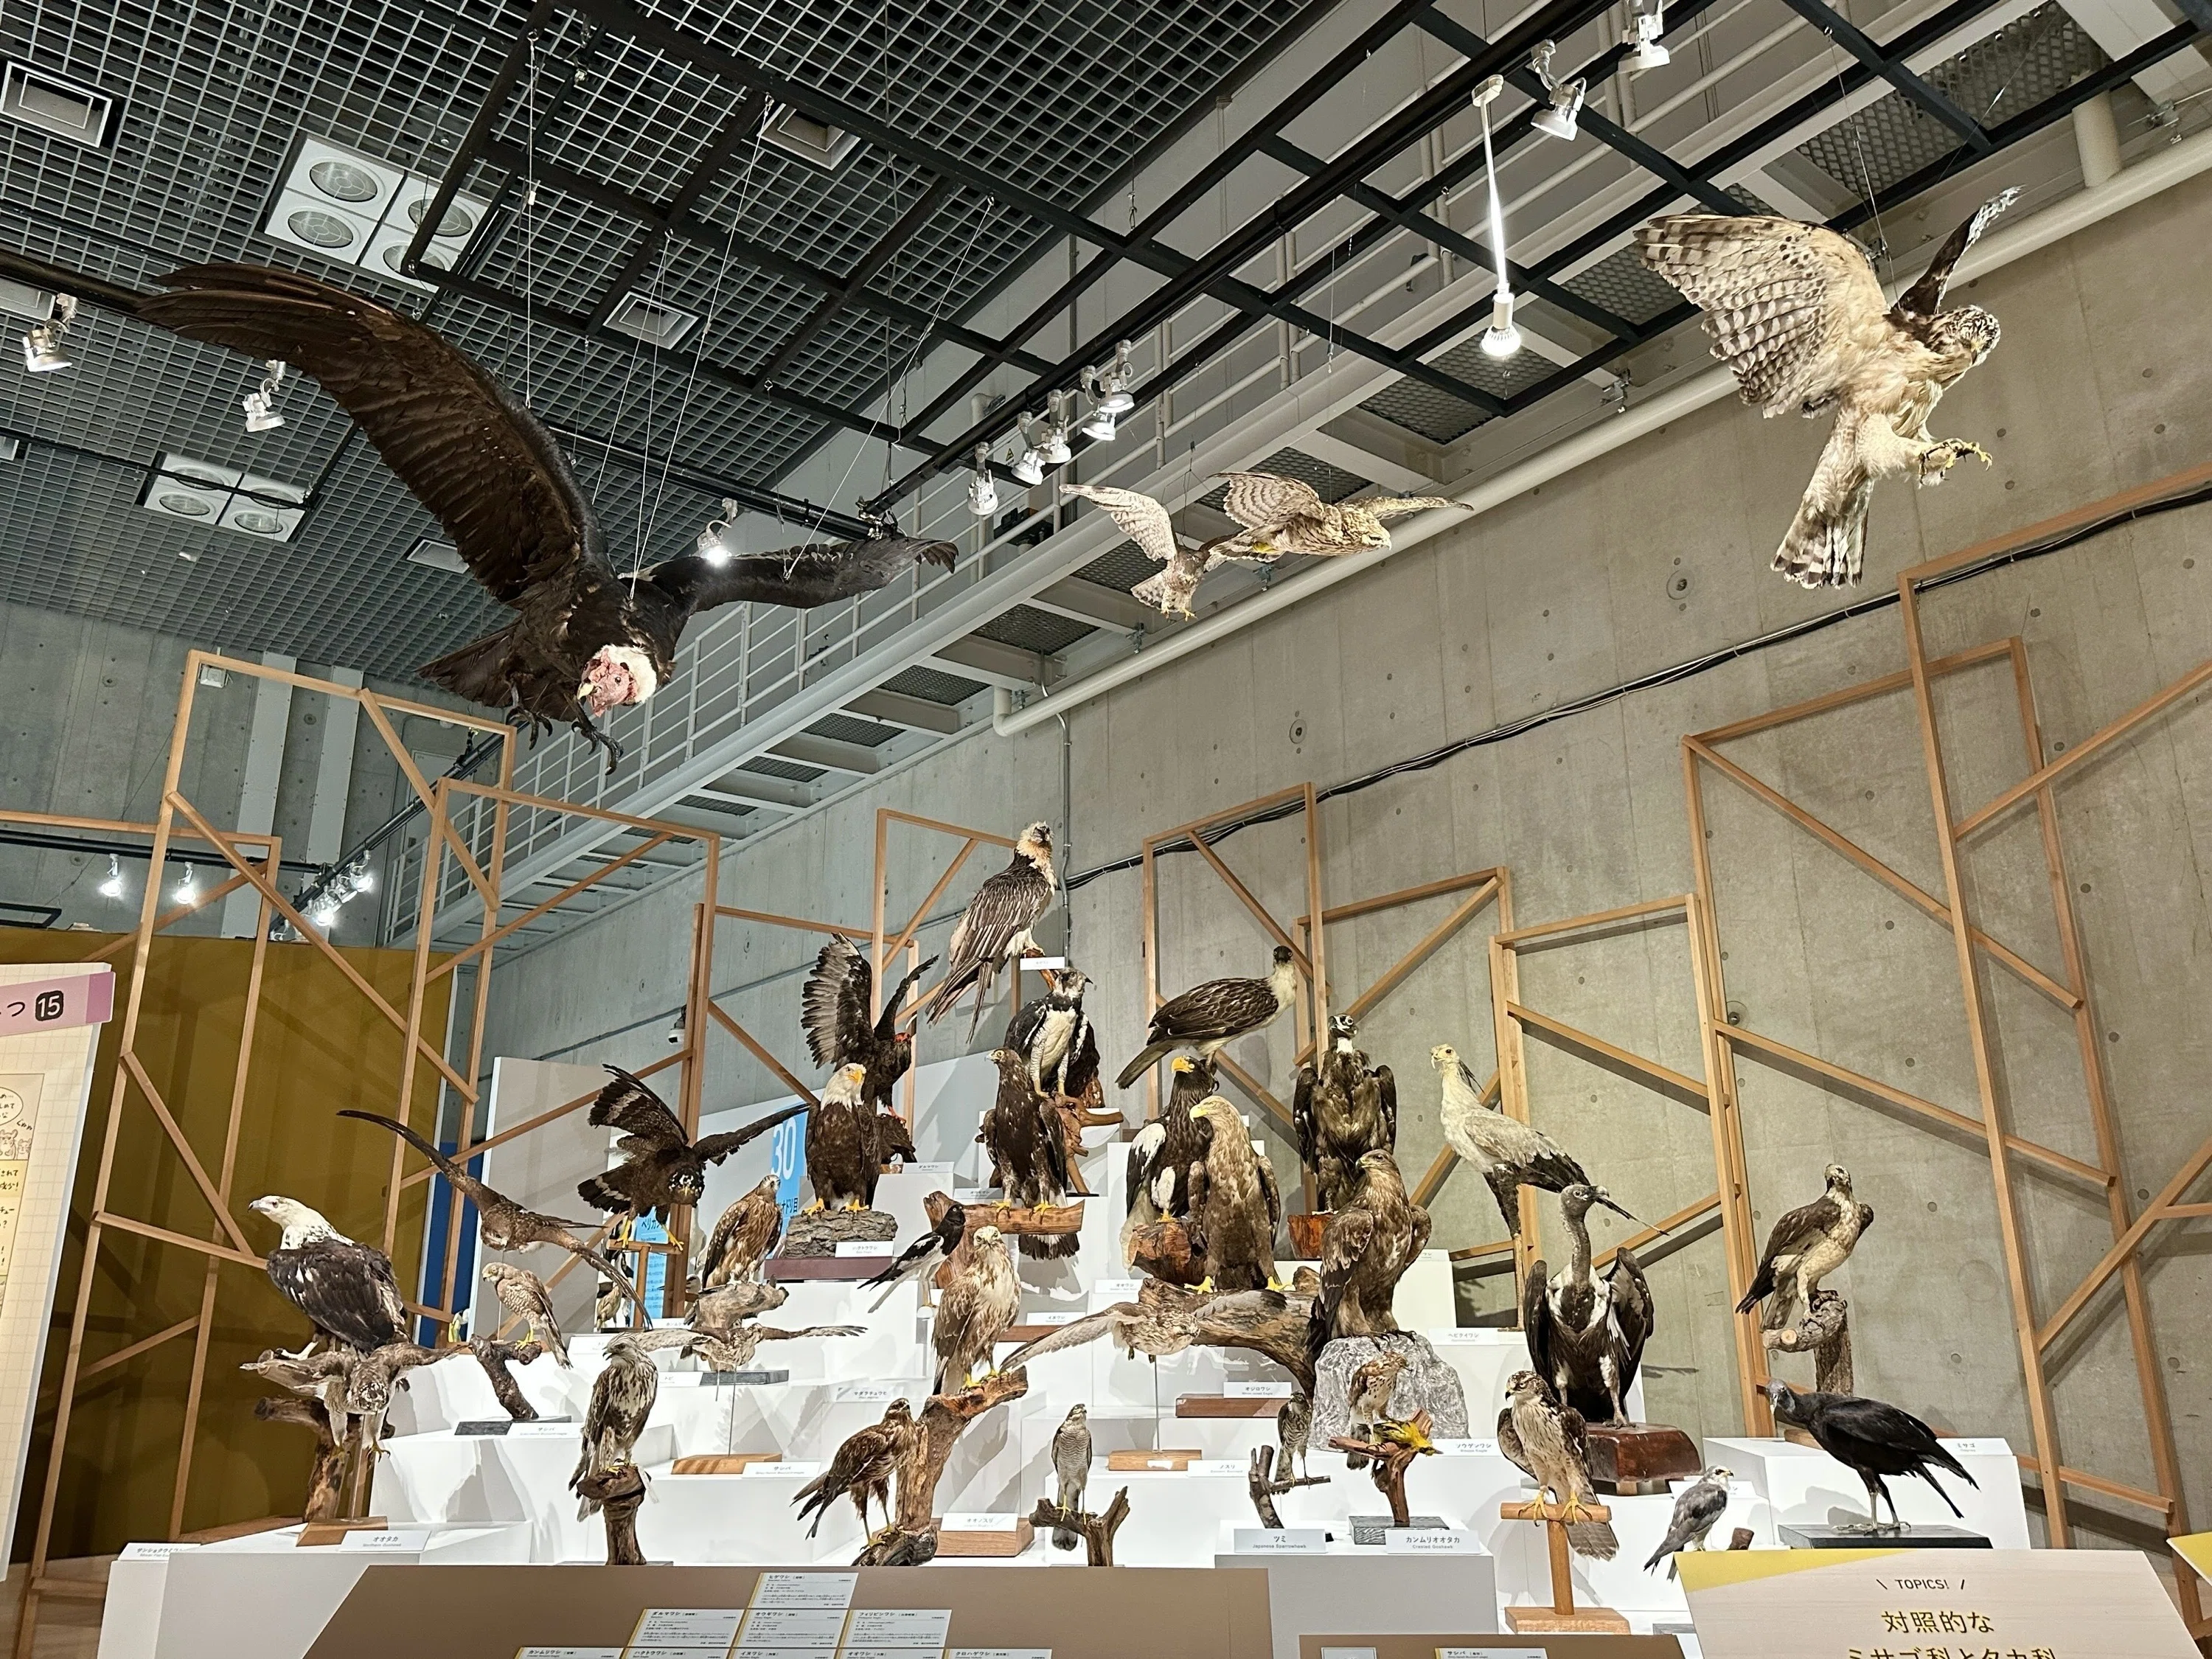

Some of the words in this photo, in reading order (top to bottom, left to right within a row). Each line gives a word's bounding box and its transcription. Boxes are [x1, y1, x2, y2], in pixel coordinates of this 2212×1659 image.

[38, 995, 60, 1018] 15
[771, 1117, 796, 1180] 30
[779, 1197, 798, 1214] オドリ目
[1894, 1579, 1950, 1590] TOPICS!
[1881, 1610, 1994, 1634] 対照的な
